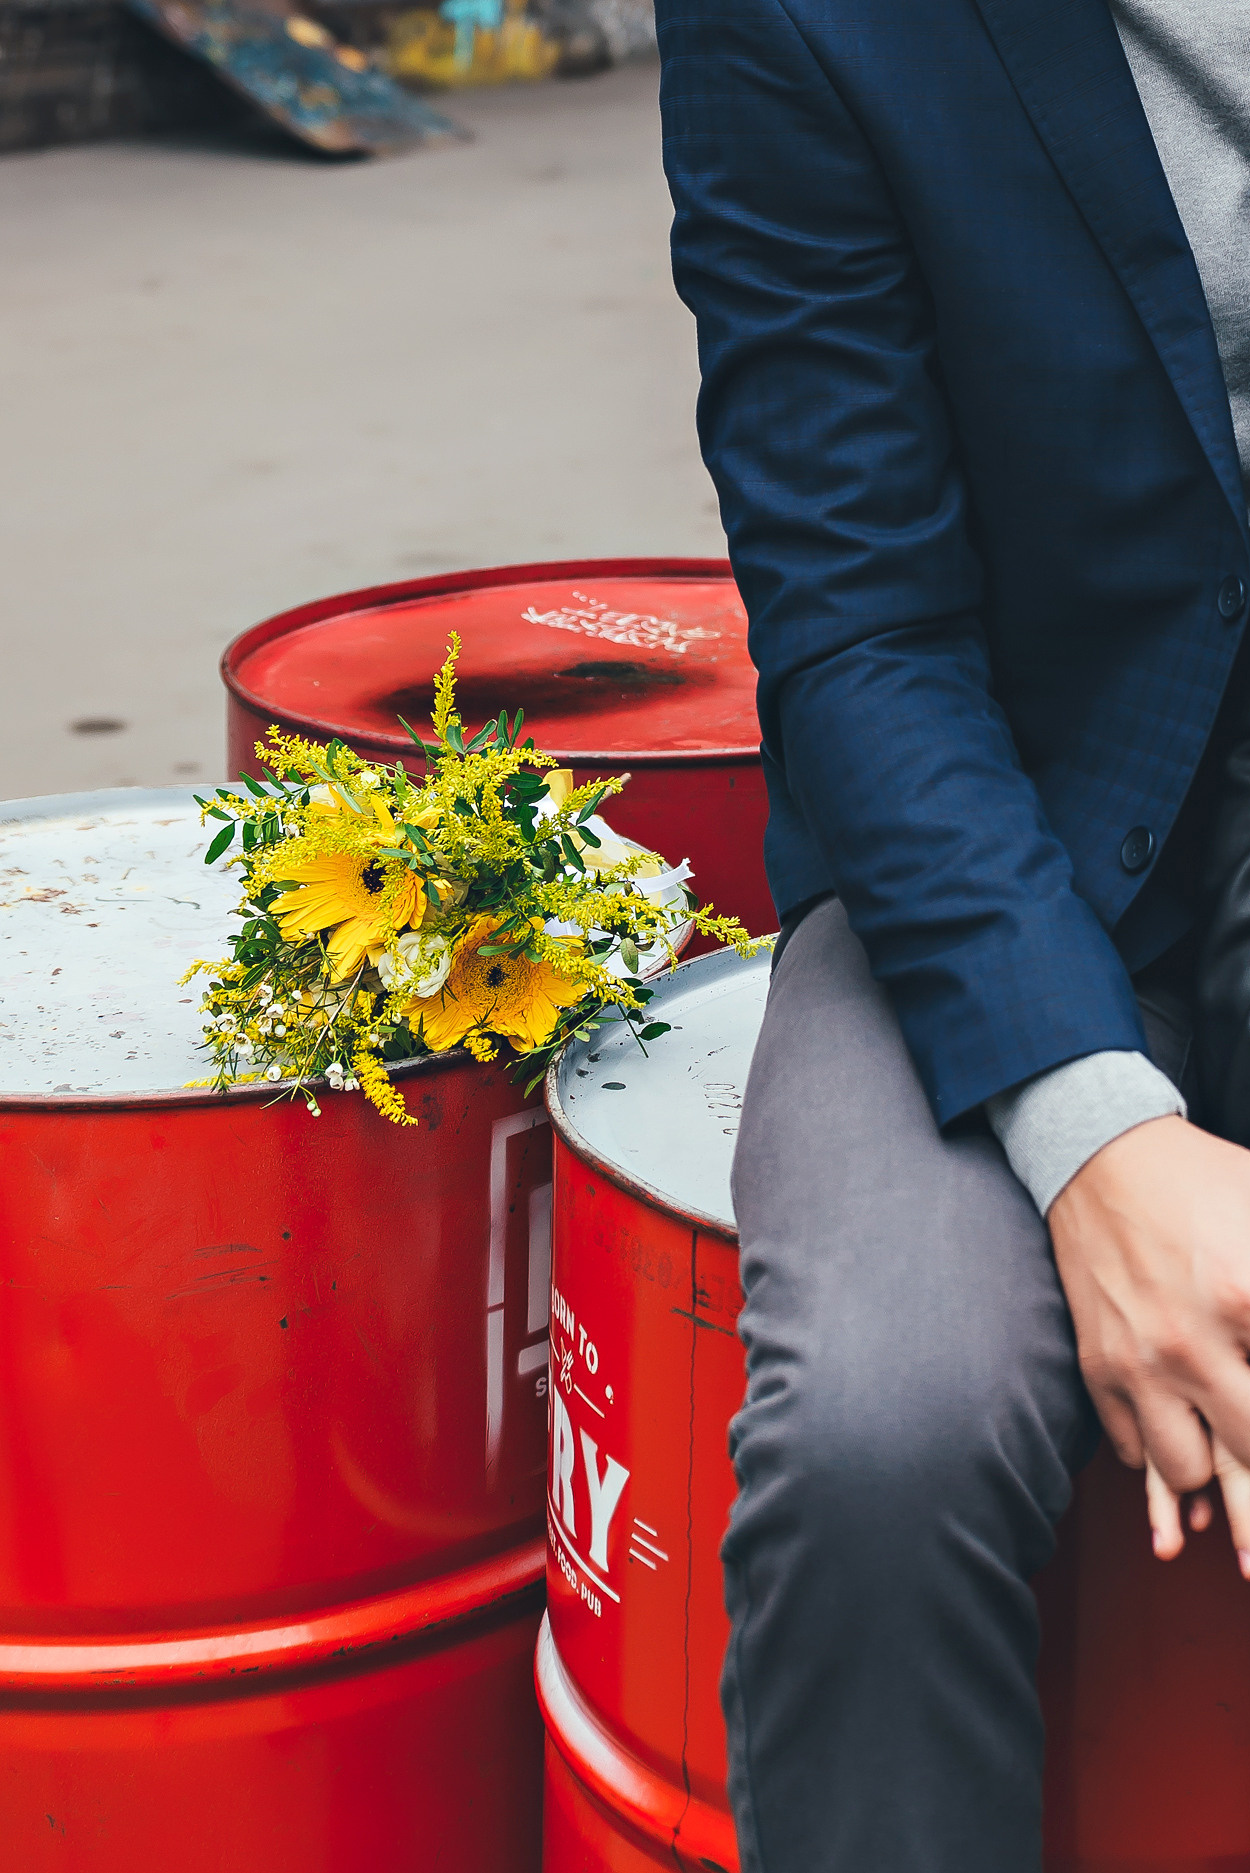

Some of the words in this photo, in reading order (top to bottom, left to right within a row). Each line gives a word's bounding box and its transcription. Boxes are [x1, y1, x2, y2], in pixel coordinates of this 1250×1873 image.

[579, 1323, 599, 1375] TO
[549, 1380, 630, 1574] RY
[581, 1582, 602, 1618] PUB
